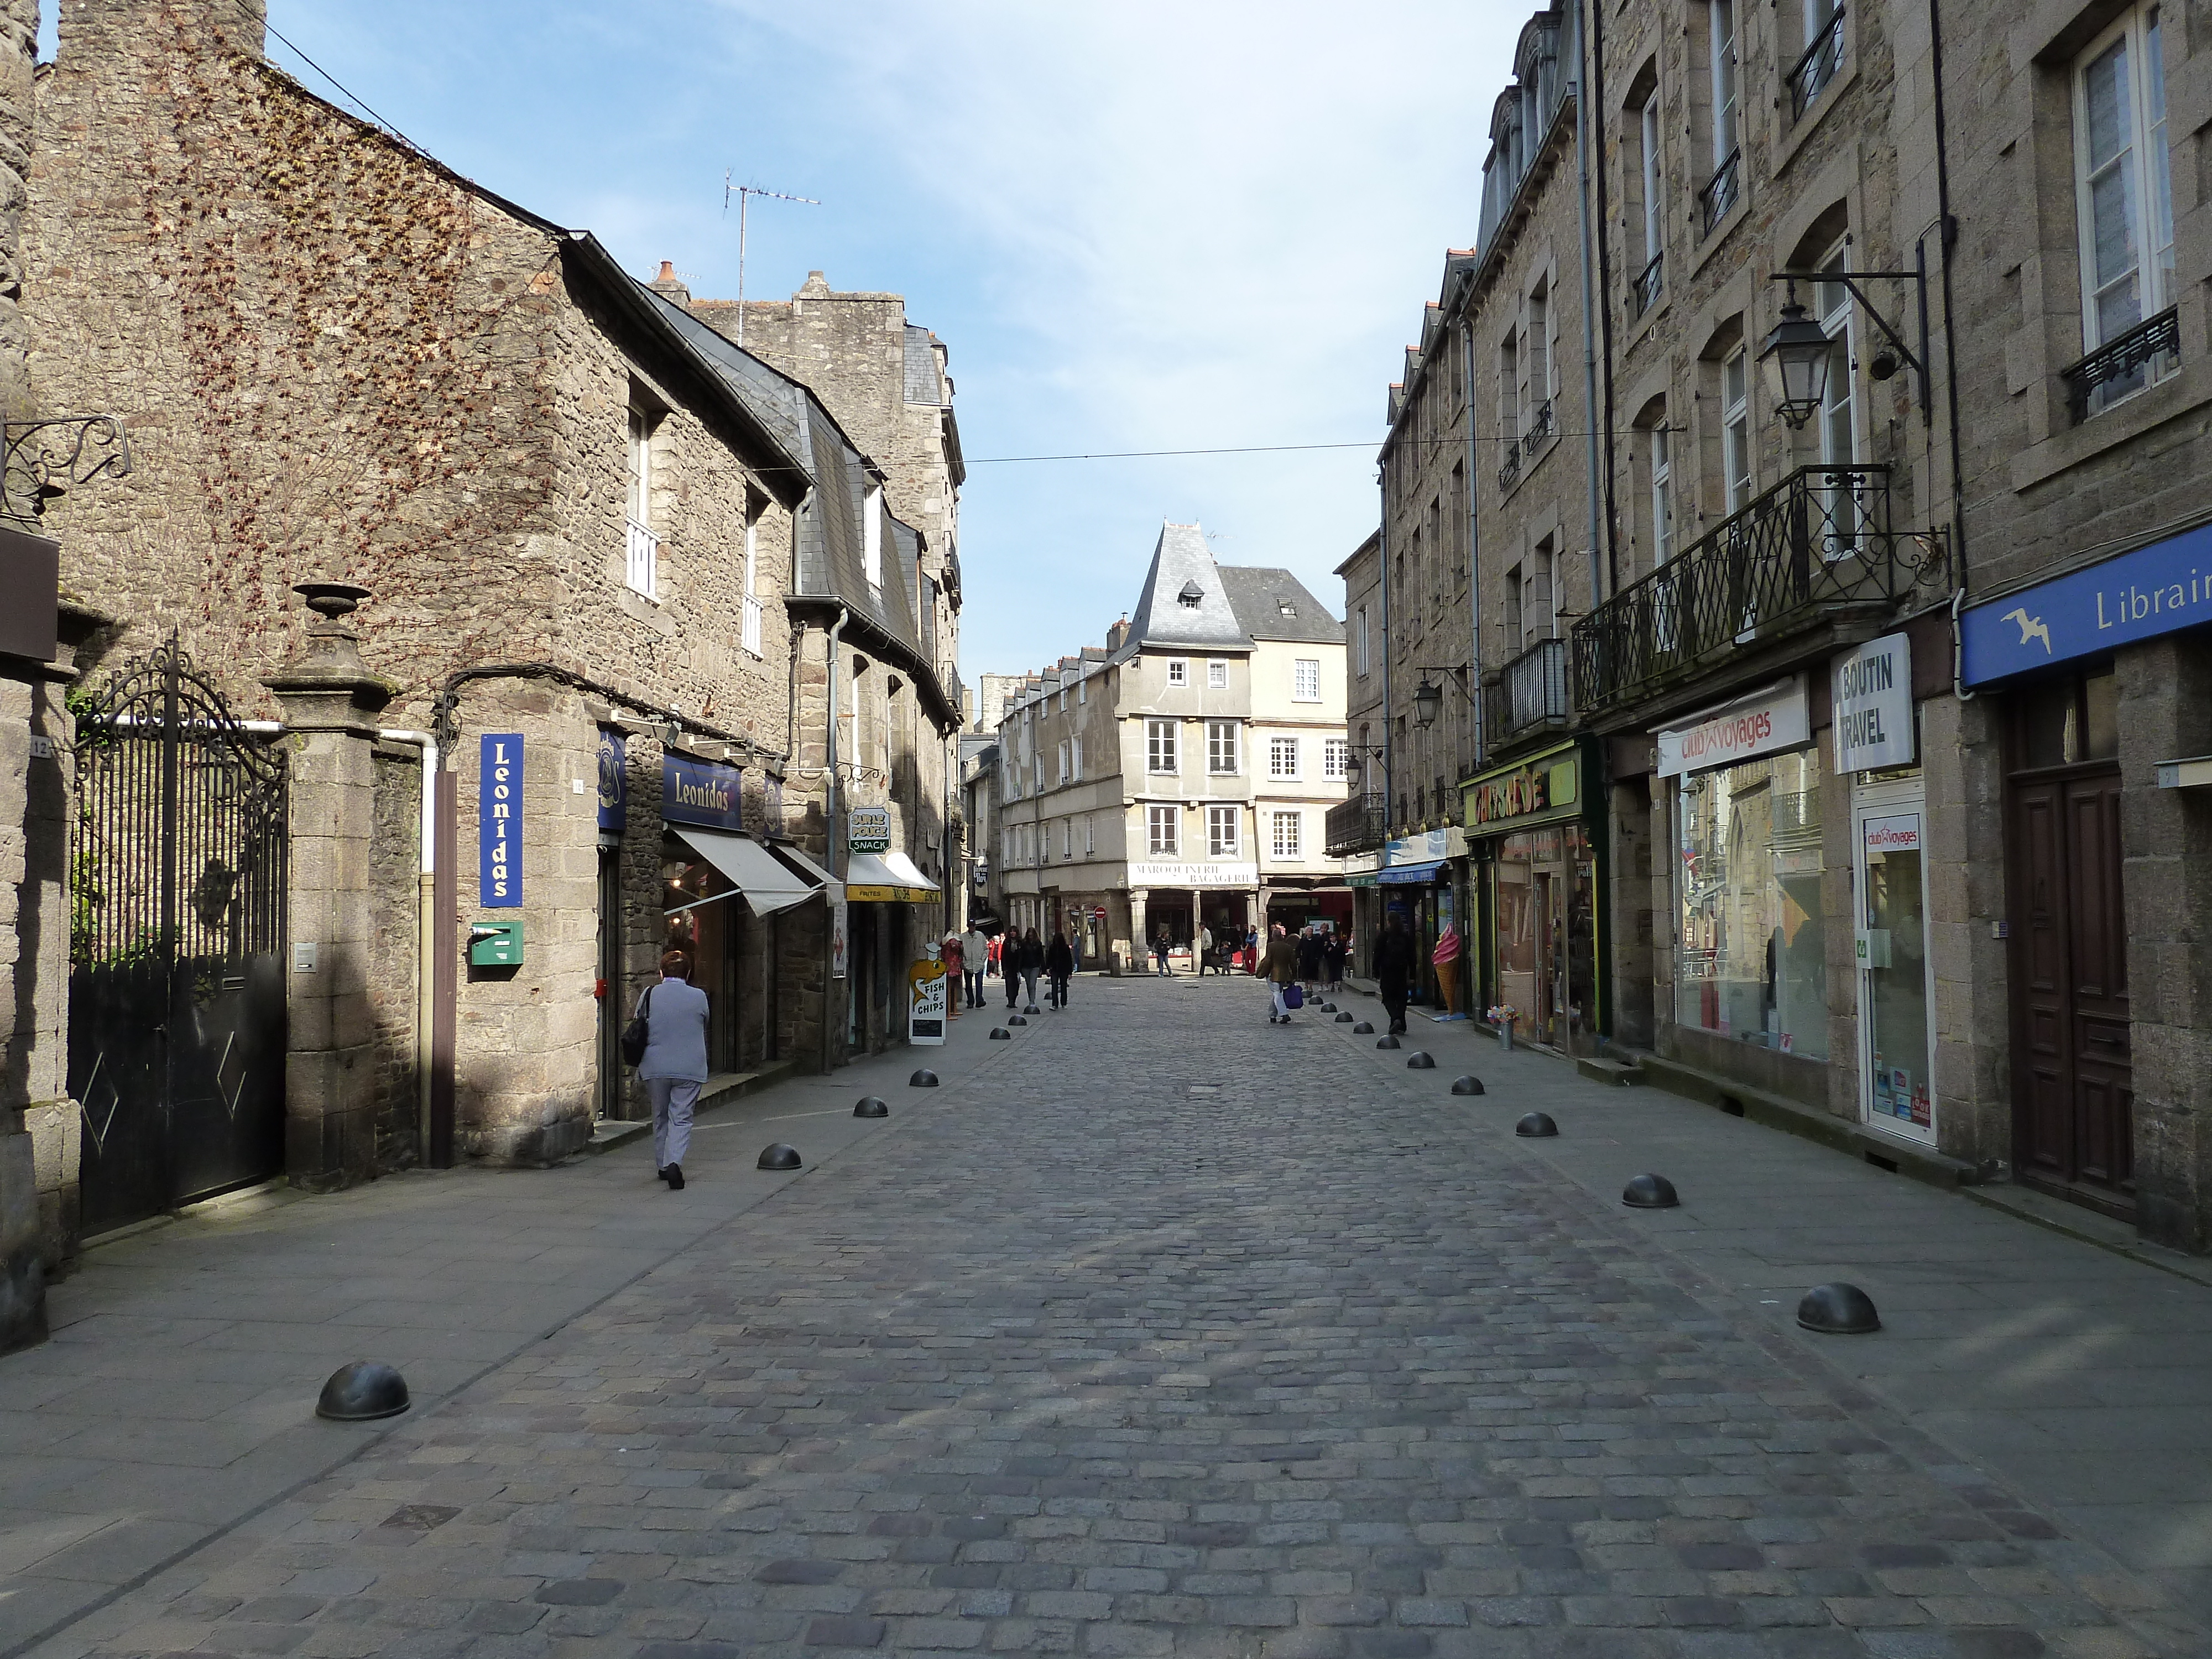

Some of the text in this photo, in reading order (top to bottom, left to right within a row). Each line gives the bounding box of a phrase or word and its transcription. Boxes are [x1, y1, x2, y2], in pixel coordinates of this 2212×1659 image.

[1682, 711, 1772, 759] club voyages
[1840, 707, 1885, 751] TRAVEL
[35, 742, 47, 753] 12
[675, 772, 728, 811] Leonidas
[492, 743, 511, 897] Leonidas
[852, 813, 885, 825] SUR LE
[852, 826, 888, 837] POUCE
[1869, 831, 1917, 846] club voyages
[854, 841, 886, 850] SNACK
[1190, 874, 1252, 883] BAGAGERIE
[925, 982, 944, 994] FISH
[918, 1001, 943, 1014] CHIPS
